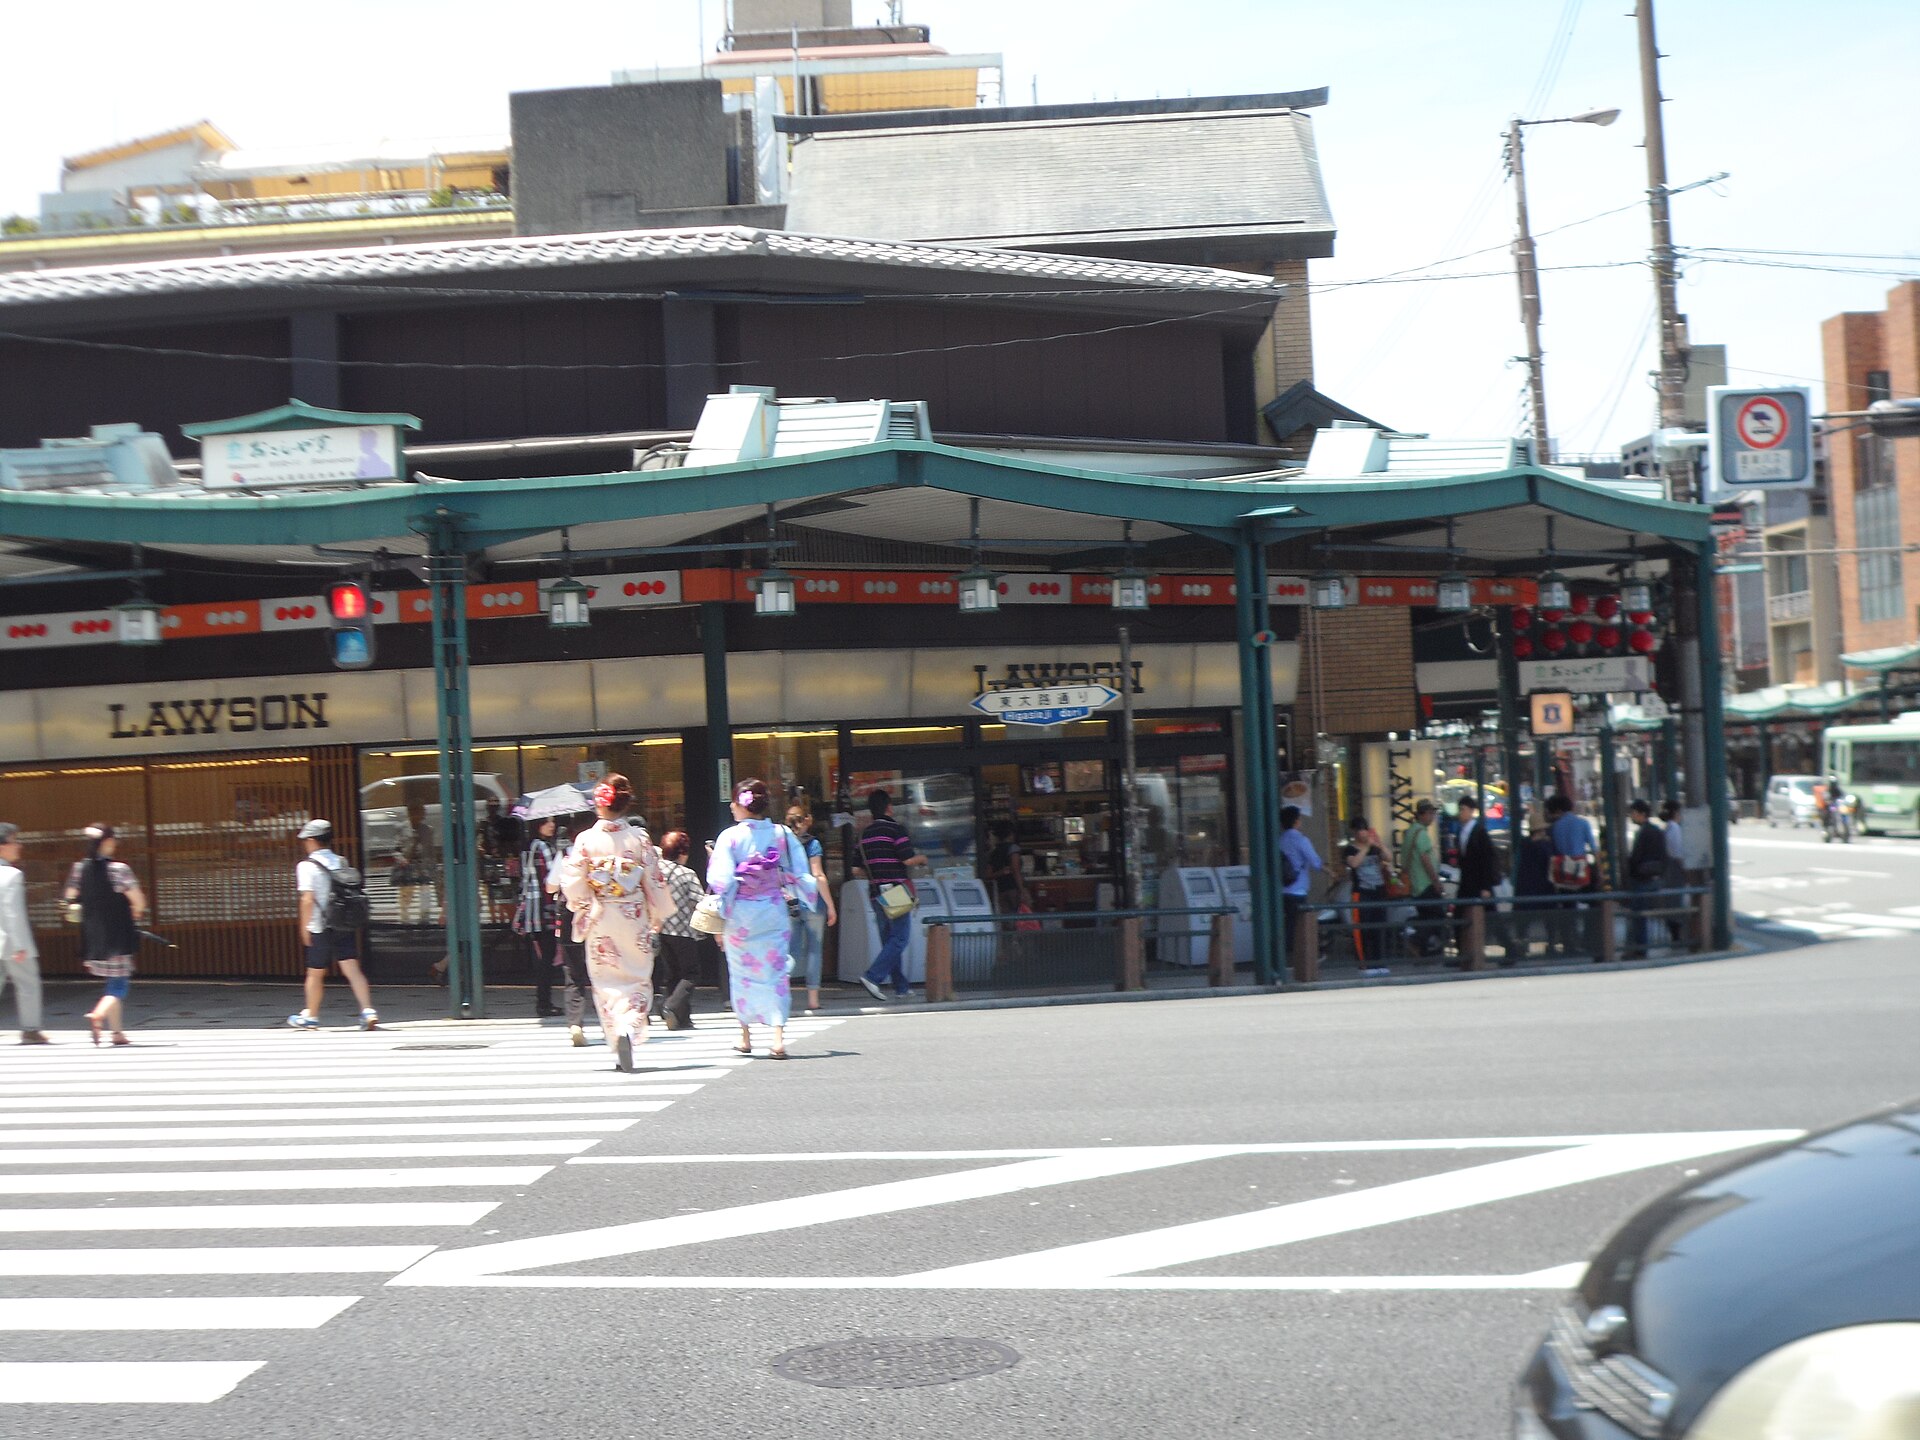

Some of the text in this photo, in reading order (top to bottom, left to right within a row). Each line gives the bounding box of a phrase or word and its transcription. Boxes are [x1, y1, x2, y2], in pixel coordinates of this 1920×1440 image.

[1000, 691, 1089, 708] 東大路通り
[109, 693, 329, 738] LAWSON
